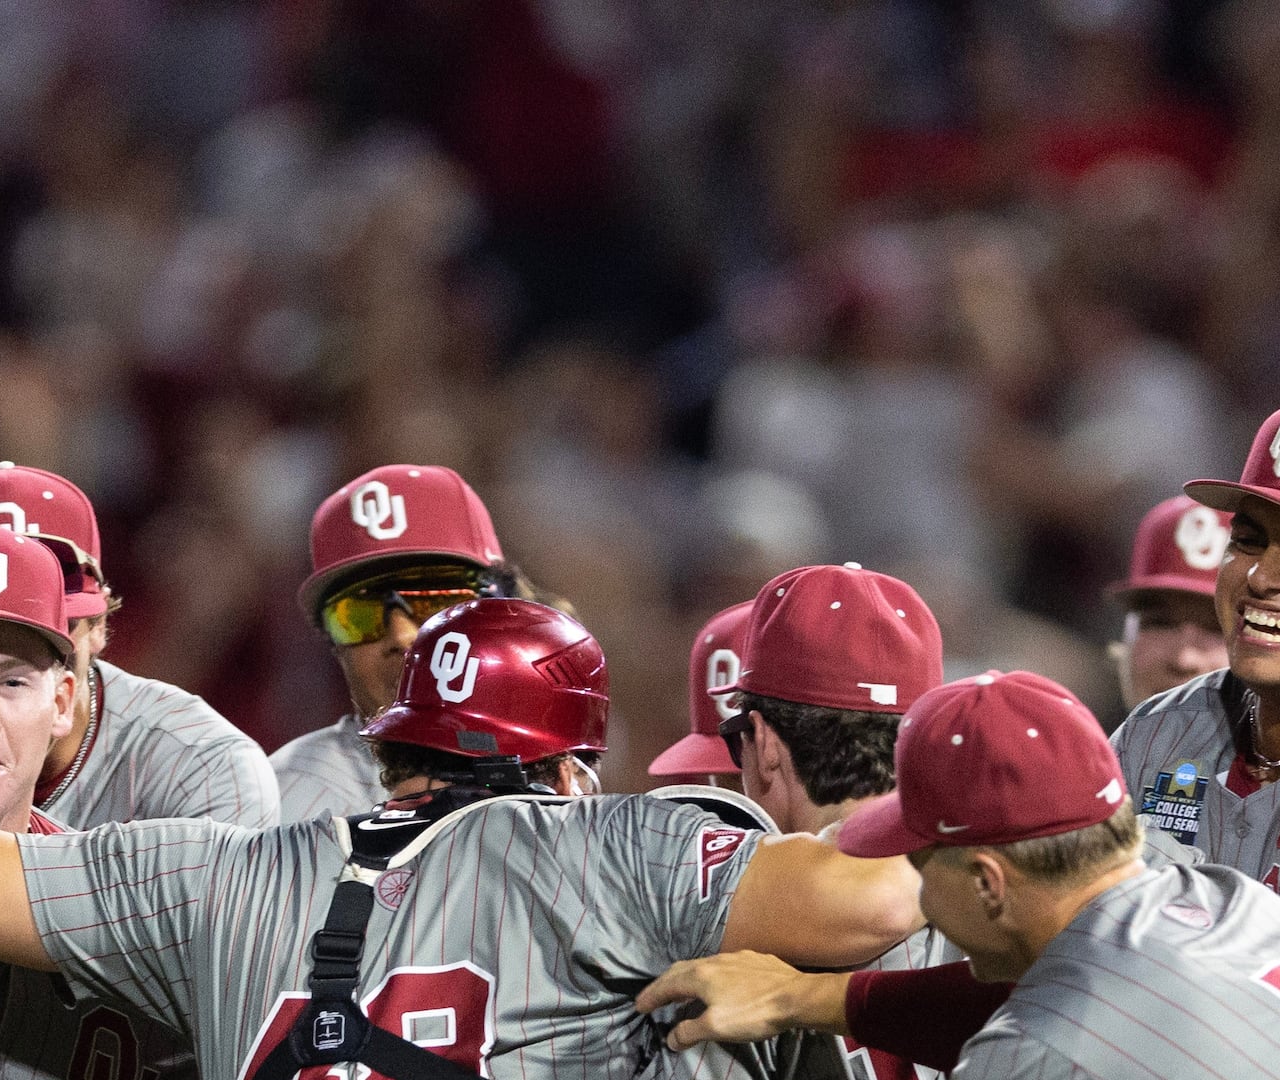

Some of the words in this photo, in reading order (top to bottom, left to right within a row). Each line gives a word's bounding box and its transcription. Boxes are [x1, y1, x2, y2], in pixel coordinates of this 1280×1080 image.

[352, 481, 407, 540] OU
[1175, 506, 1231, 570] OU
[430, 632, 481, 704] OU
[1155, 802, 1199, 819] COLLEGE
